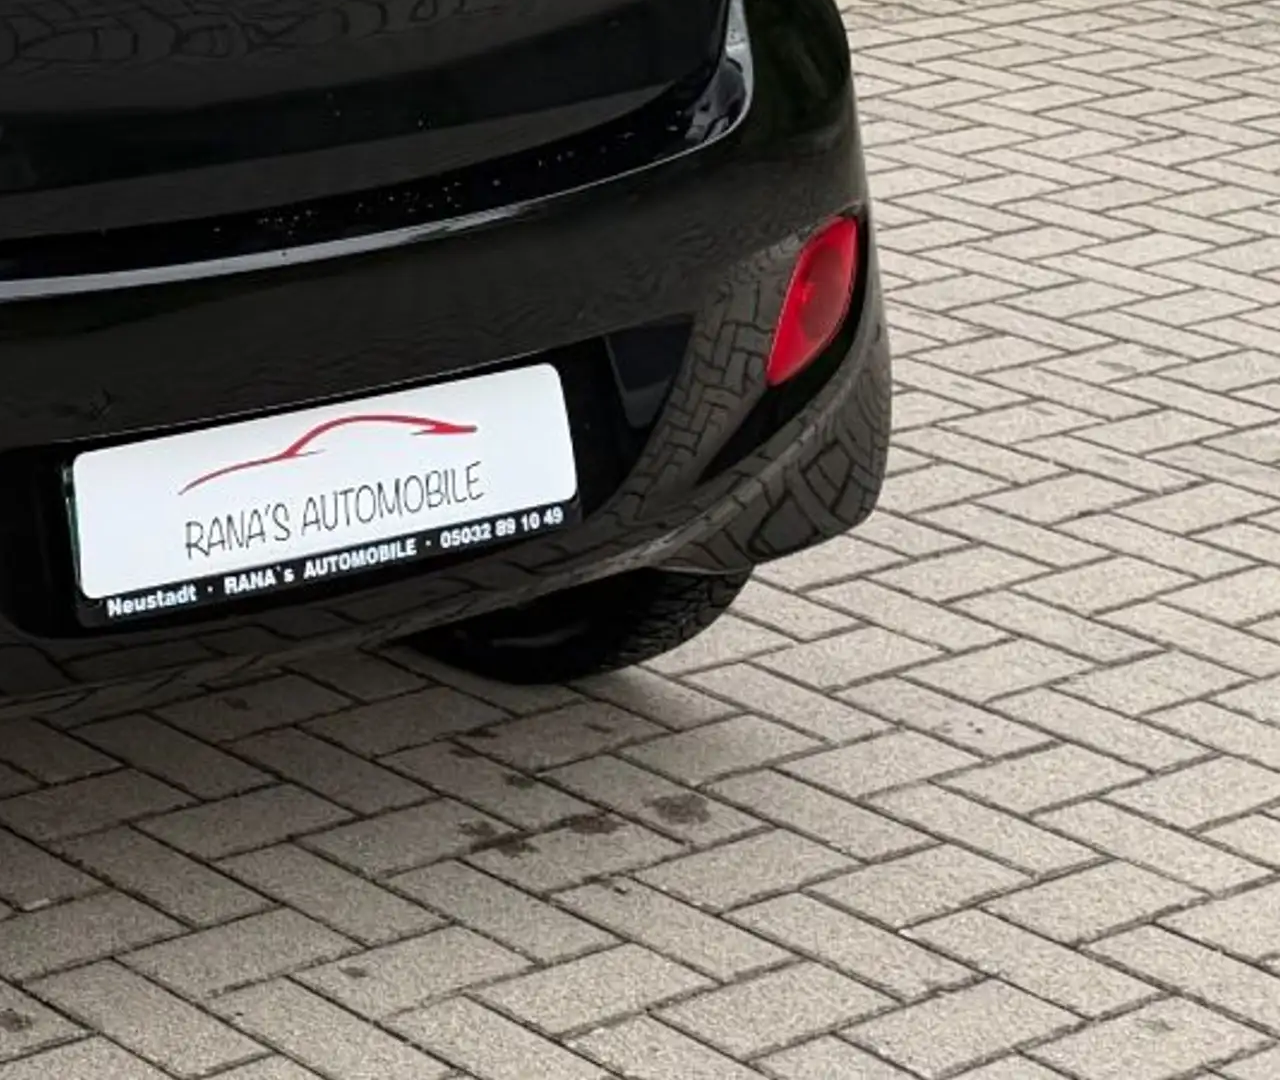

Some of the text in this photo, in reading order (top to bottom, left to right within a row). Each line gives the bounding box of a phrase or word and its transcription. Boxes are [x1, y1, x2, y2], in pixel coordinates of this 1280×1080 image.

[105, 582, 198, 617] Neustadt
[302, 537, 418, 580] AUTOMOBILE
[440, 521, 493, 549] 05032
[495, 517, 517, 538] 89
[520, 511, 541, 532] 10
[543, 506, 564, 525] 49
[185, 460, 485, 560] RANA'S AUTOMOBILE
